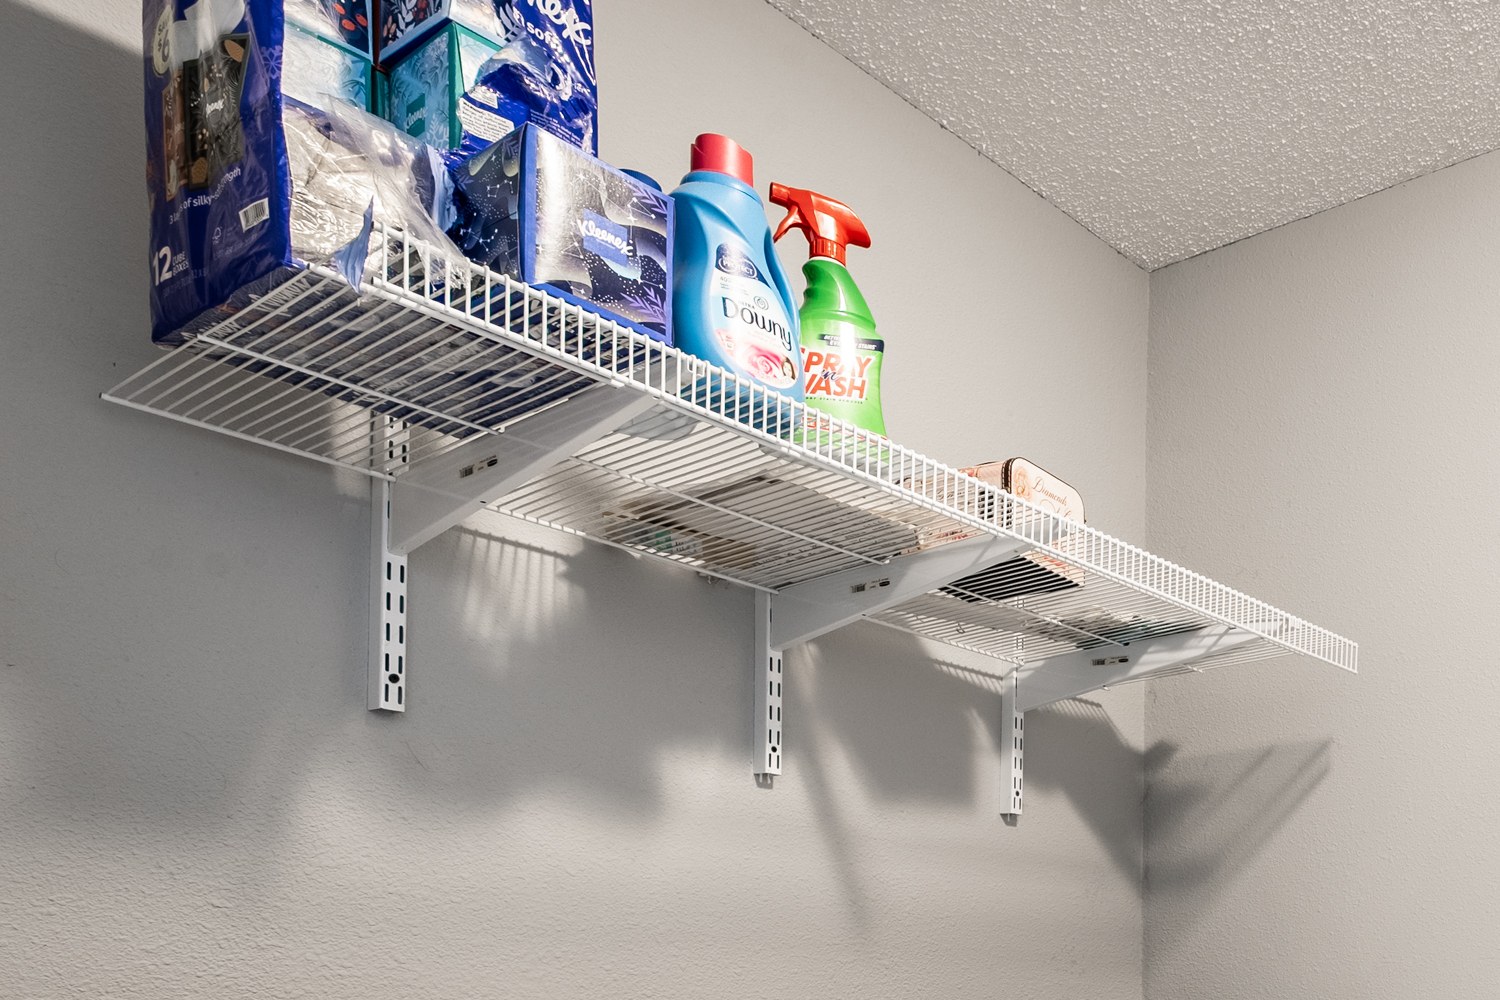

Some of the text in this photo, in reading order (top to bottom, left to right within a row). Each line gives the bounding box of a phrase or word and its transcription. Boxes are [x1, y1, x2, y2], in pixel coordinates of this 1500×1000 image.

[402, 105, 429, 130] Kleenex
[183, 197, 191, 210] of
[576, 219, 634, 257] Kleenex
[152, 246, 173, 287] 12
[172, 251, 186, 266] CUBE
[172, 260, 189, 277] BOXES
[721, 296, 793, 352] Downy
[1031, 475, 1068, 507] Diamonds
